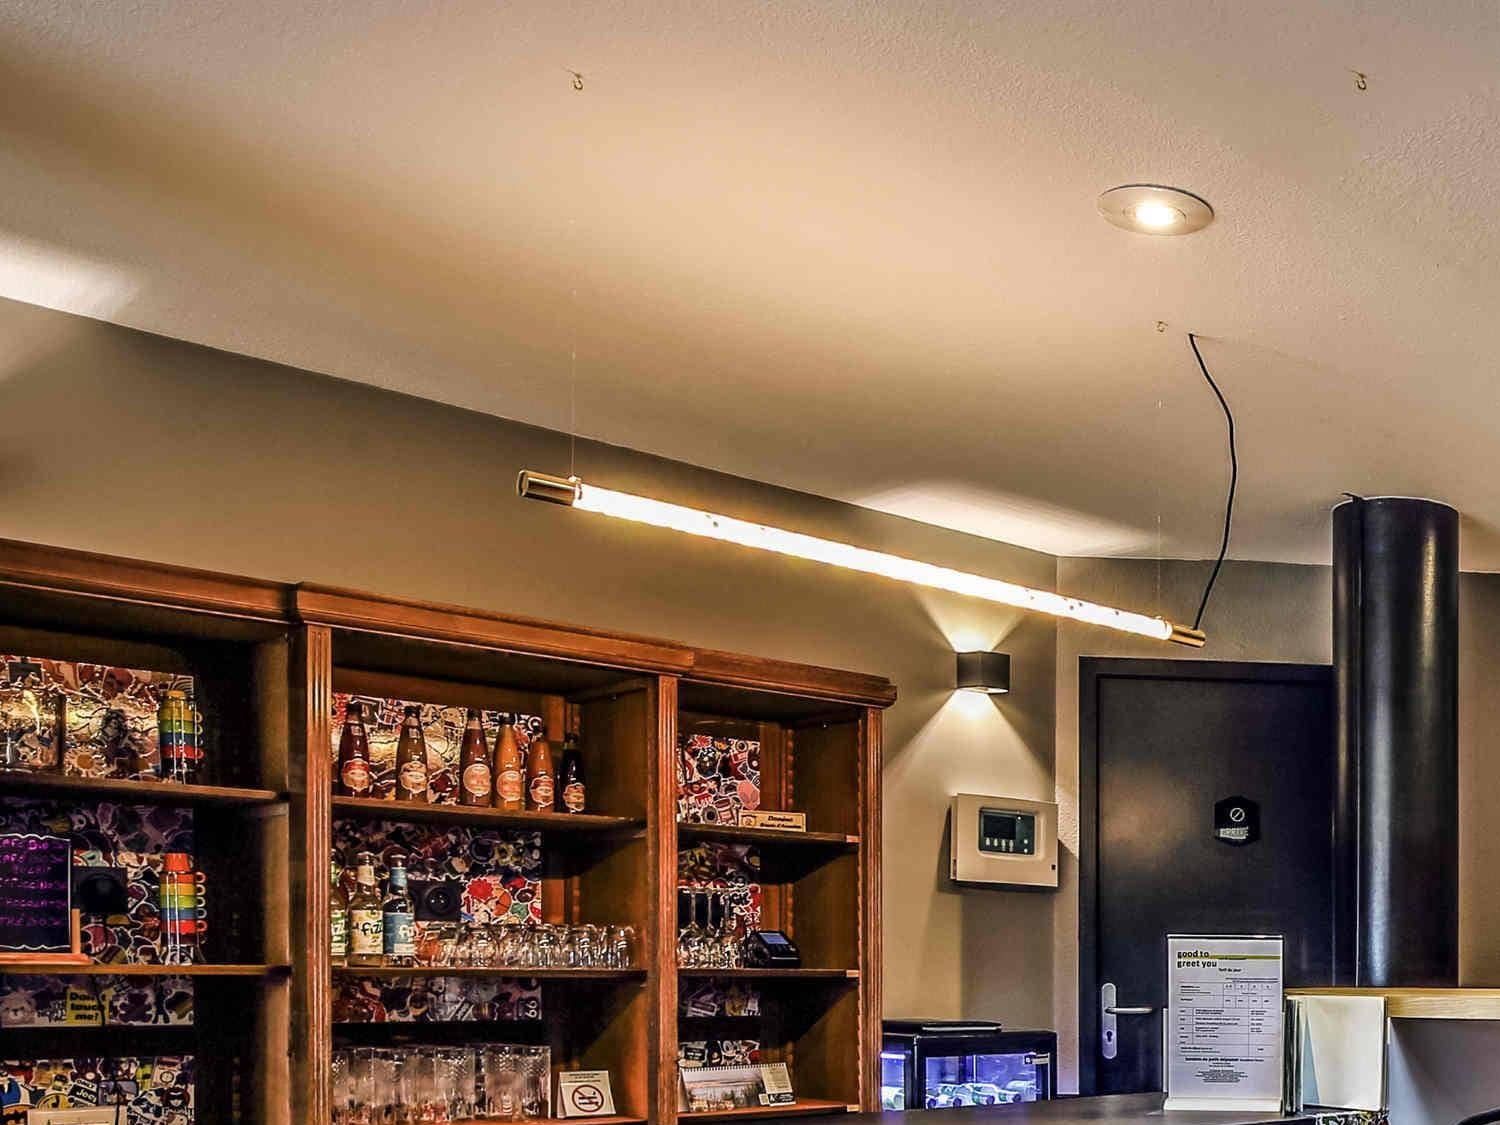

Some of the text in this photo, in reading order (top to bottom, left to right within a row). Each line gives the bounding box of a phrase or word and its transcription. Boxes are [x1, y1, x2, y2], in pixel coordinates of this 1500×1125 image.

[1177, 950, 1209, 959] good to
[1177, 960, 1217, 968] greet you
